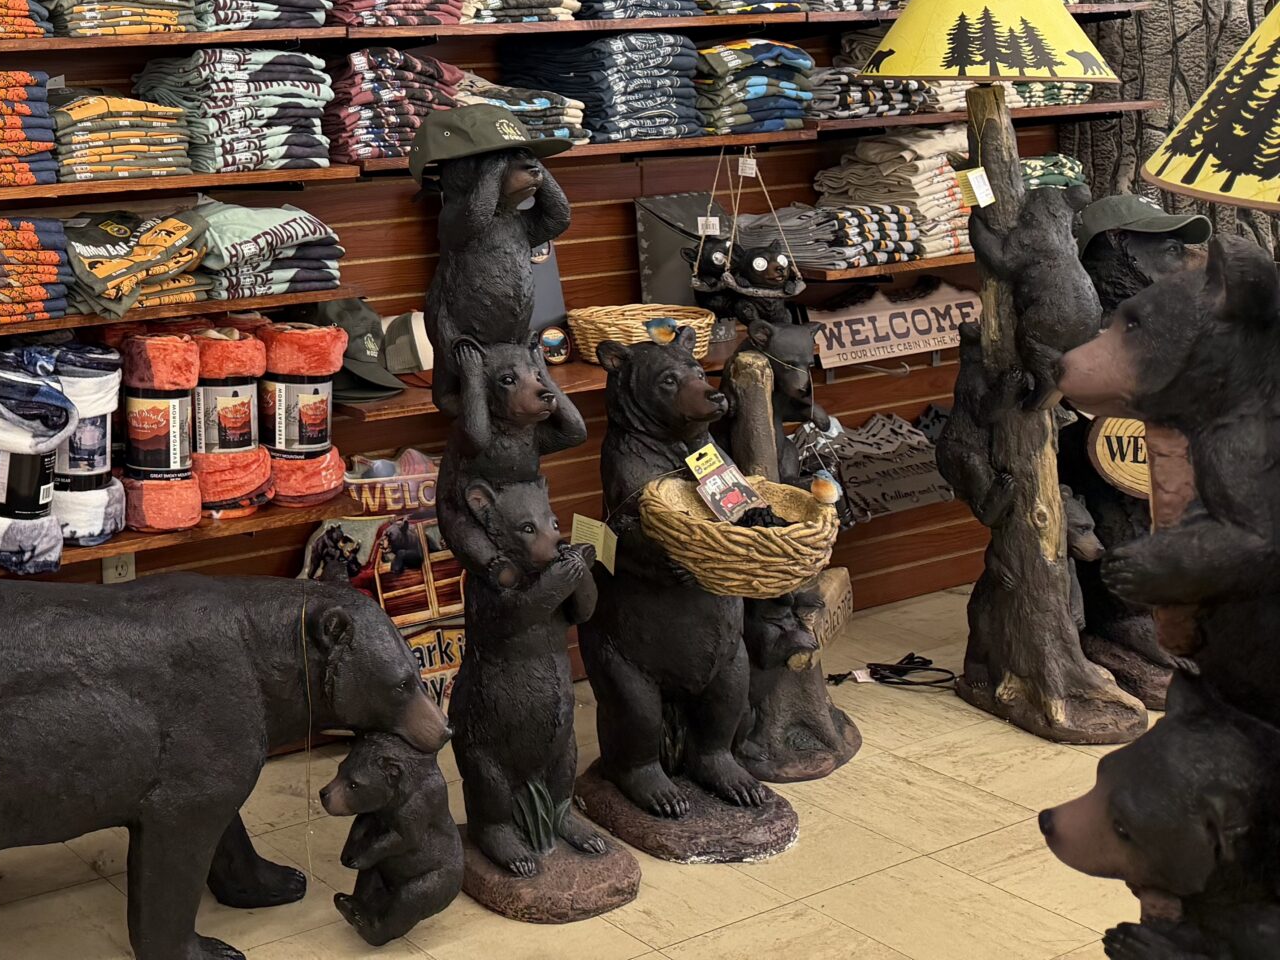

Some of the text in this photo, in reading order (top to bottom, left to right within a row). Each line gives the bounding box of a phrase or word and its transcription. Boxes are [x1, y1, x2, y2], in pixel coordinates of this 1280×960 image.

[224, 213, 329, 265] HERNATION
[820, 301, 979, 351] WELCOME
[837, 352, 848, 362] TO
[850, 349, 868, 360] OUR
[870, 343, 896, 357] LITTLE
[896, 340, 921, 352] CABIN
[923, 339, 931, 349] IN
[932, 336, 948, 347] THE
[349, 480, 437, 513] WELC
[414, 629, 455, 670] ark
